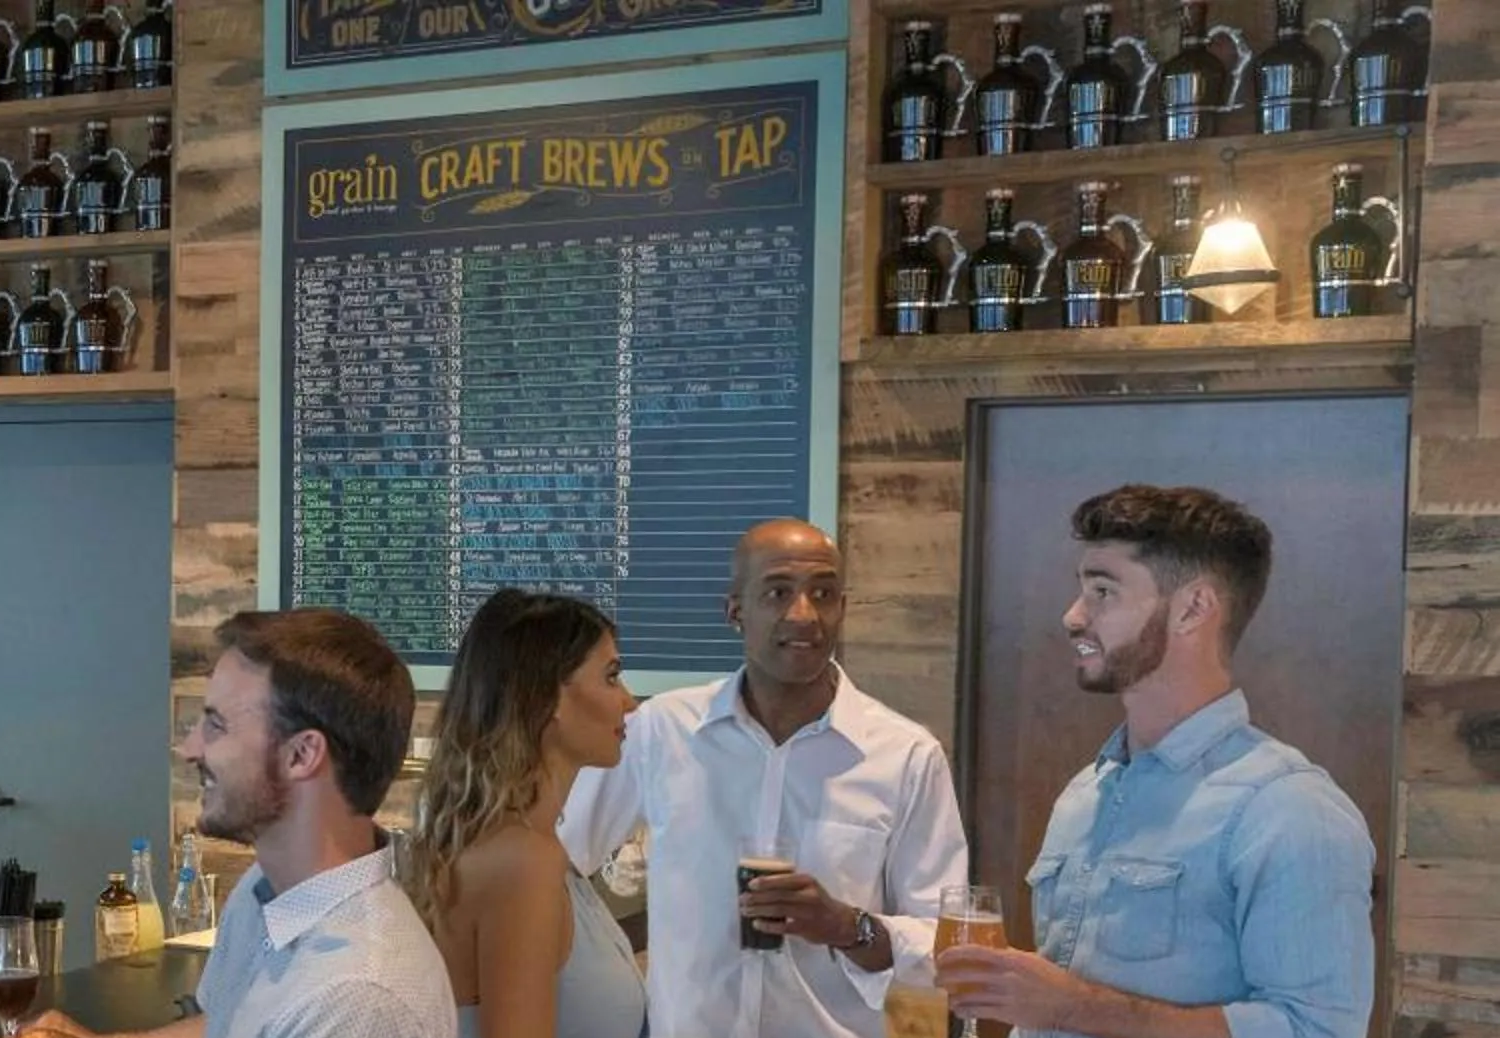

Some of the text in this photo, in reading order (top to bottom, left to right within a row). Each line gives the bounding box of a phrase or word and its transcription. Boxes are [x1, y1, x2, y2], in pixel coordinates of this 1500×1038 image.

[331, 16, 381, 47] ONE
[419, 6, 468, 37] OUR
[420, 138, 526, 199] CRAFT
[542, 137, 670, 188] BREWS
[714, 116, 787, 177] TAP
[309, 154, 397, 219] grain
